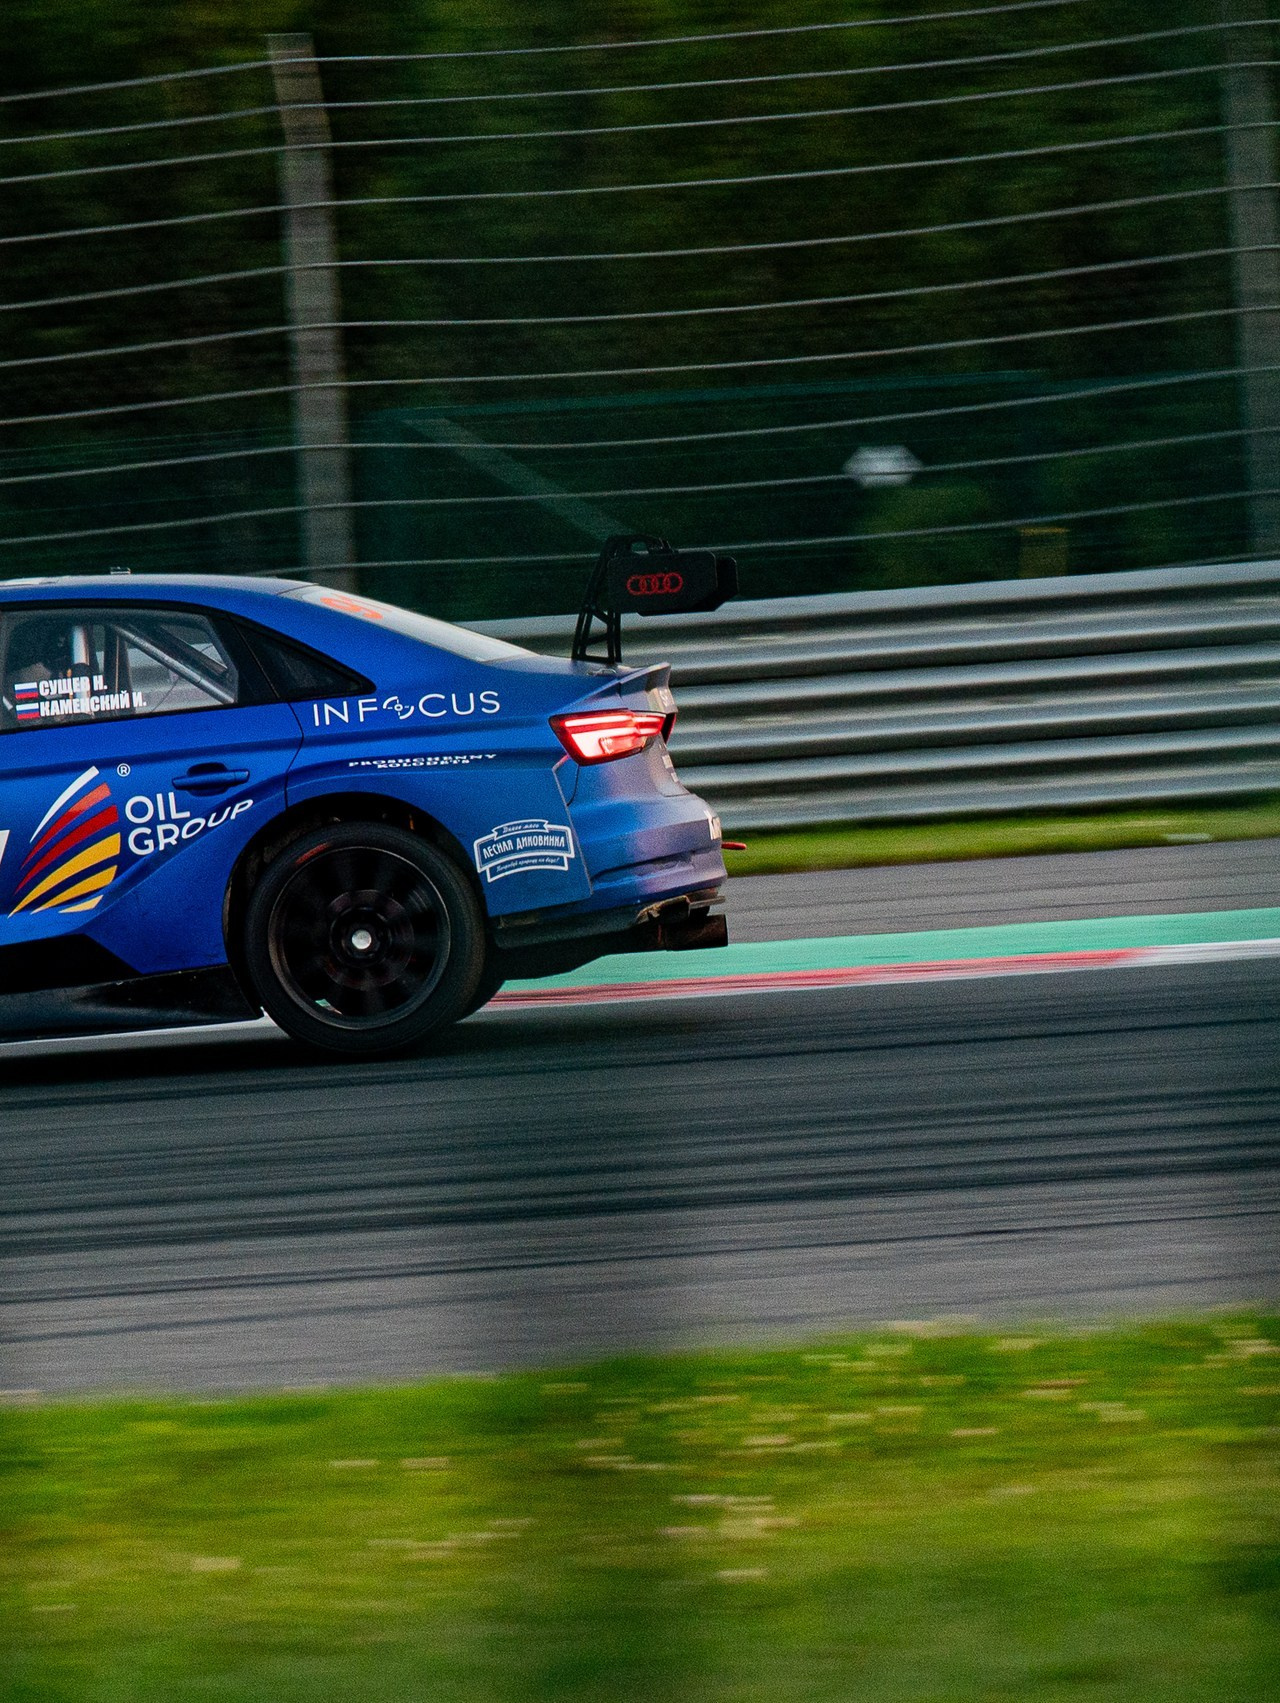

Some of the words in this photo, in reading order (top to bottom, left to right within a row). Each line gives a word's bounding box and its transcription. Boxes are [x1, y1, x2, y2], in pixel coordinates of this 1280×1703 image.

[39, 676, 91, 696] СУЩЕВ
[40, 690, 130, 717] КАМЕНСКИЙ
[133, 692, 147, 707] И.
[125, 791, 190, 824] OIL
[128, 799, 254, 856] GROUP
[482, 839, 513, 859] ЛЕСНАЯ
[516, 835, 565, 850] ДИКОВИНКА
